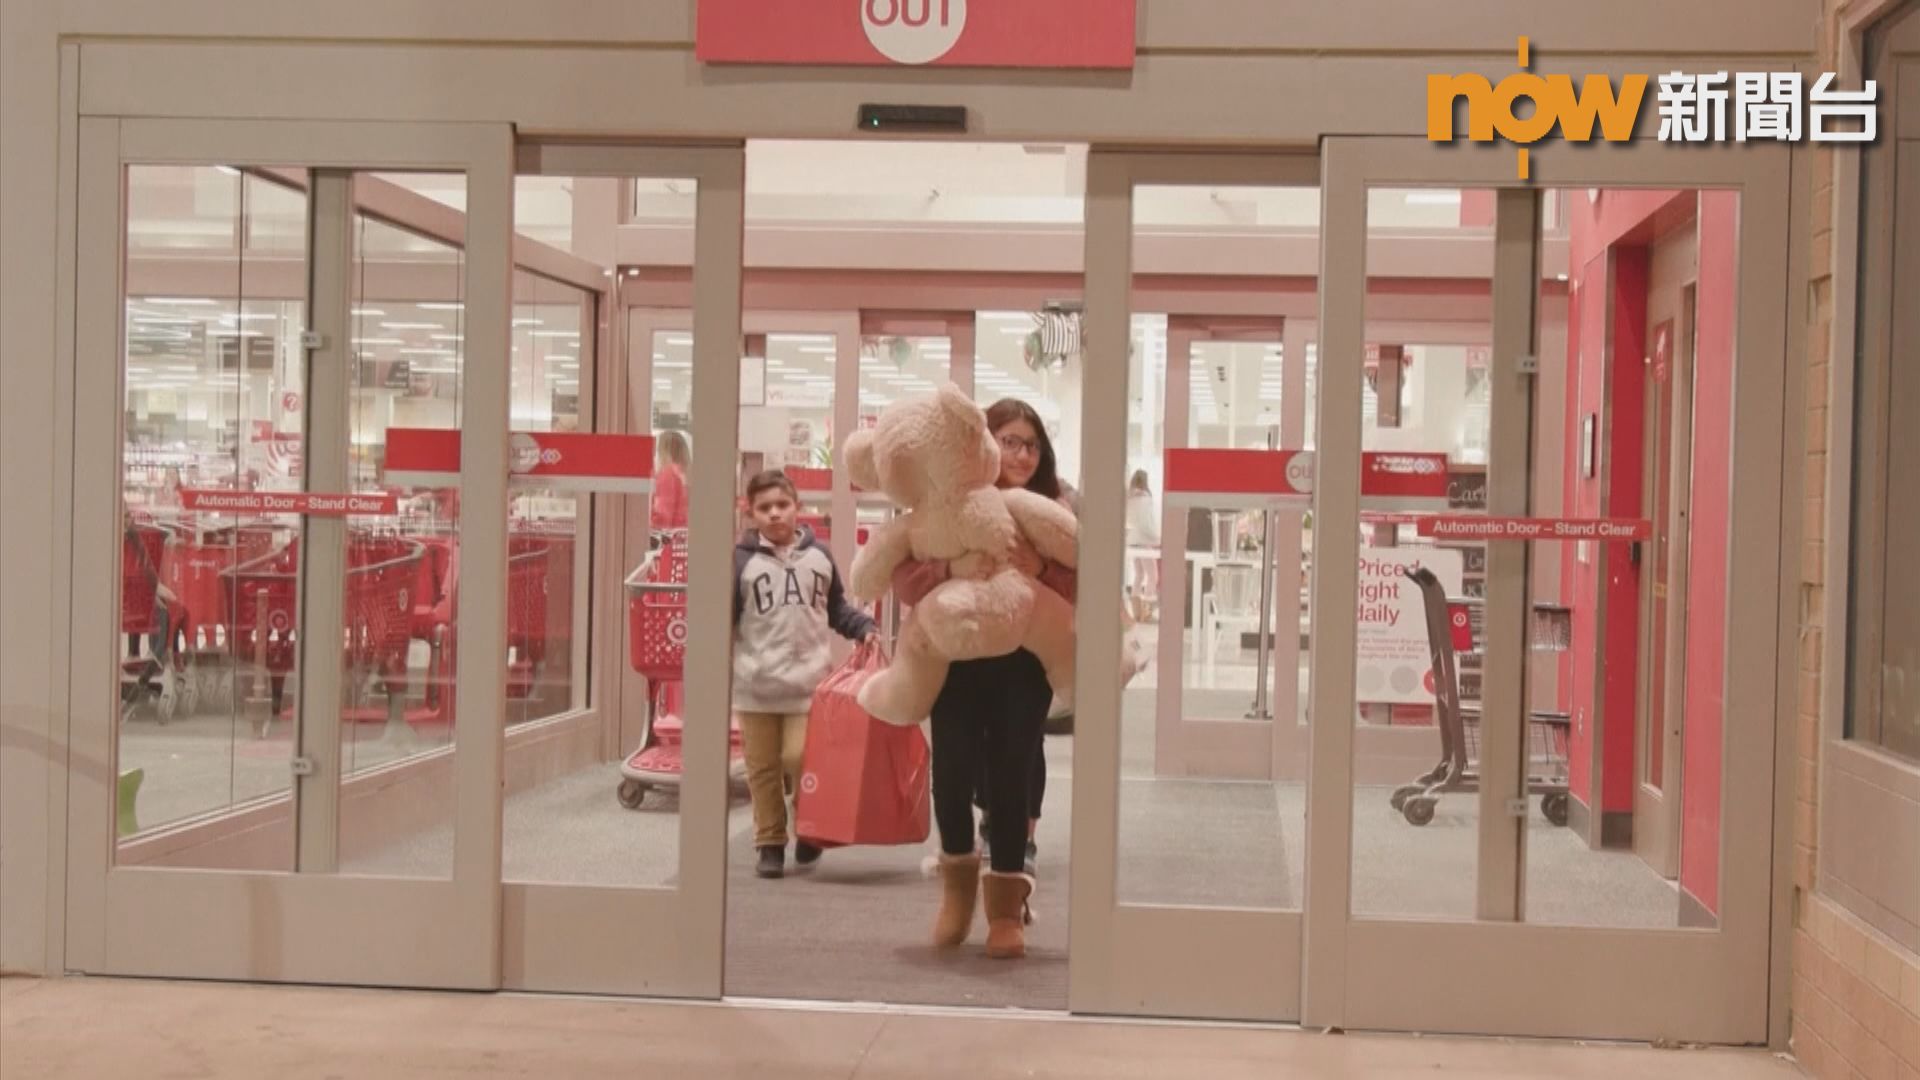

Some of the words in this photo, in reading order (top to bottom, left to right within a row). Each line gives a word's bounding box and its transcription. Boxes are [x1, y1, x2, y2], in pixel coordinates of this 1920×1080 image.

[1289, 464, 1313, 479] OU
[195, 494, 260, 508] Automatic
[263, 495, 295, 509] Door
[308, 497, 346, 510] Stand
[349, 498, 385, 511] Clear
[1433, 520, 1504, 534] Automatic
[1506, 521, 1541, 535] Door
[1555, 522, 1595, 536] Stand
[1598, 523, 1636, 536] Clear
[1360, 580, 1400, 603] ight
